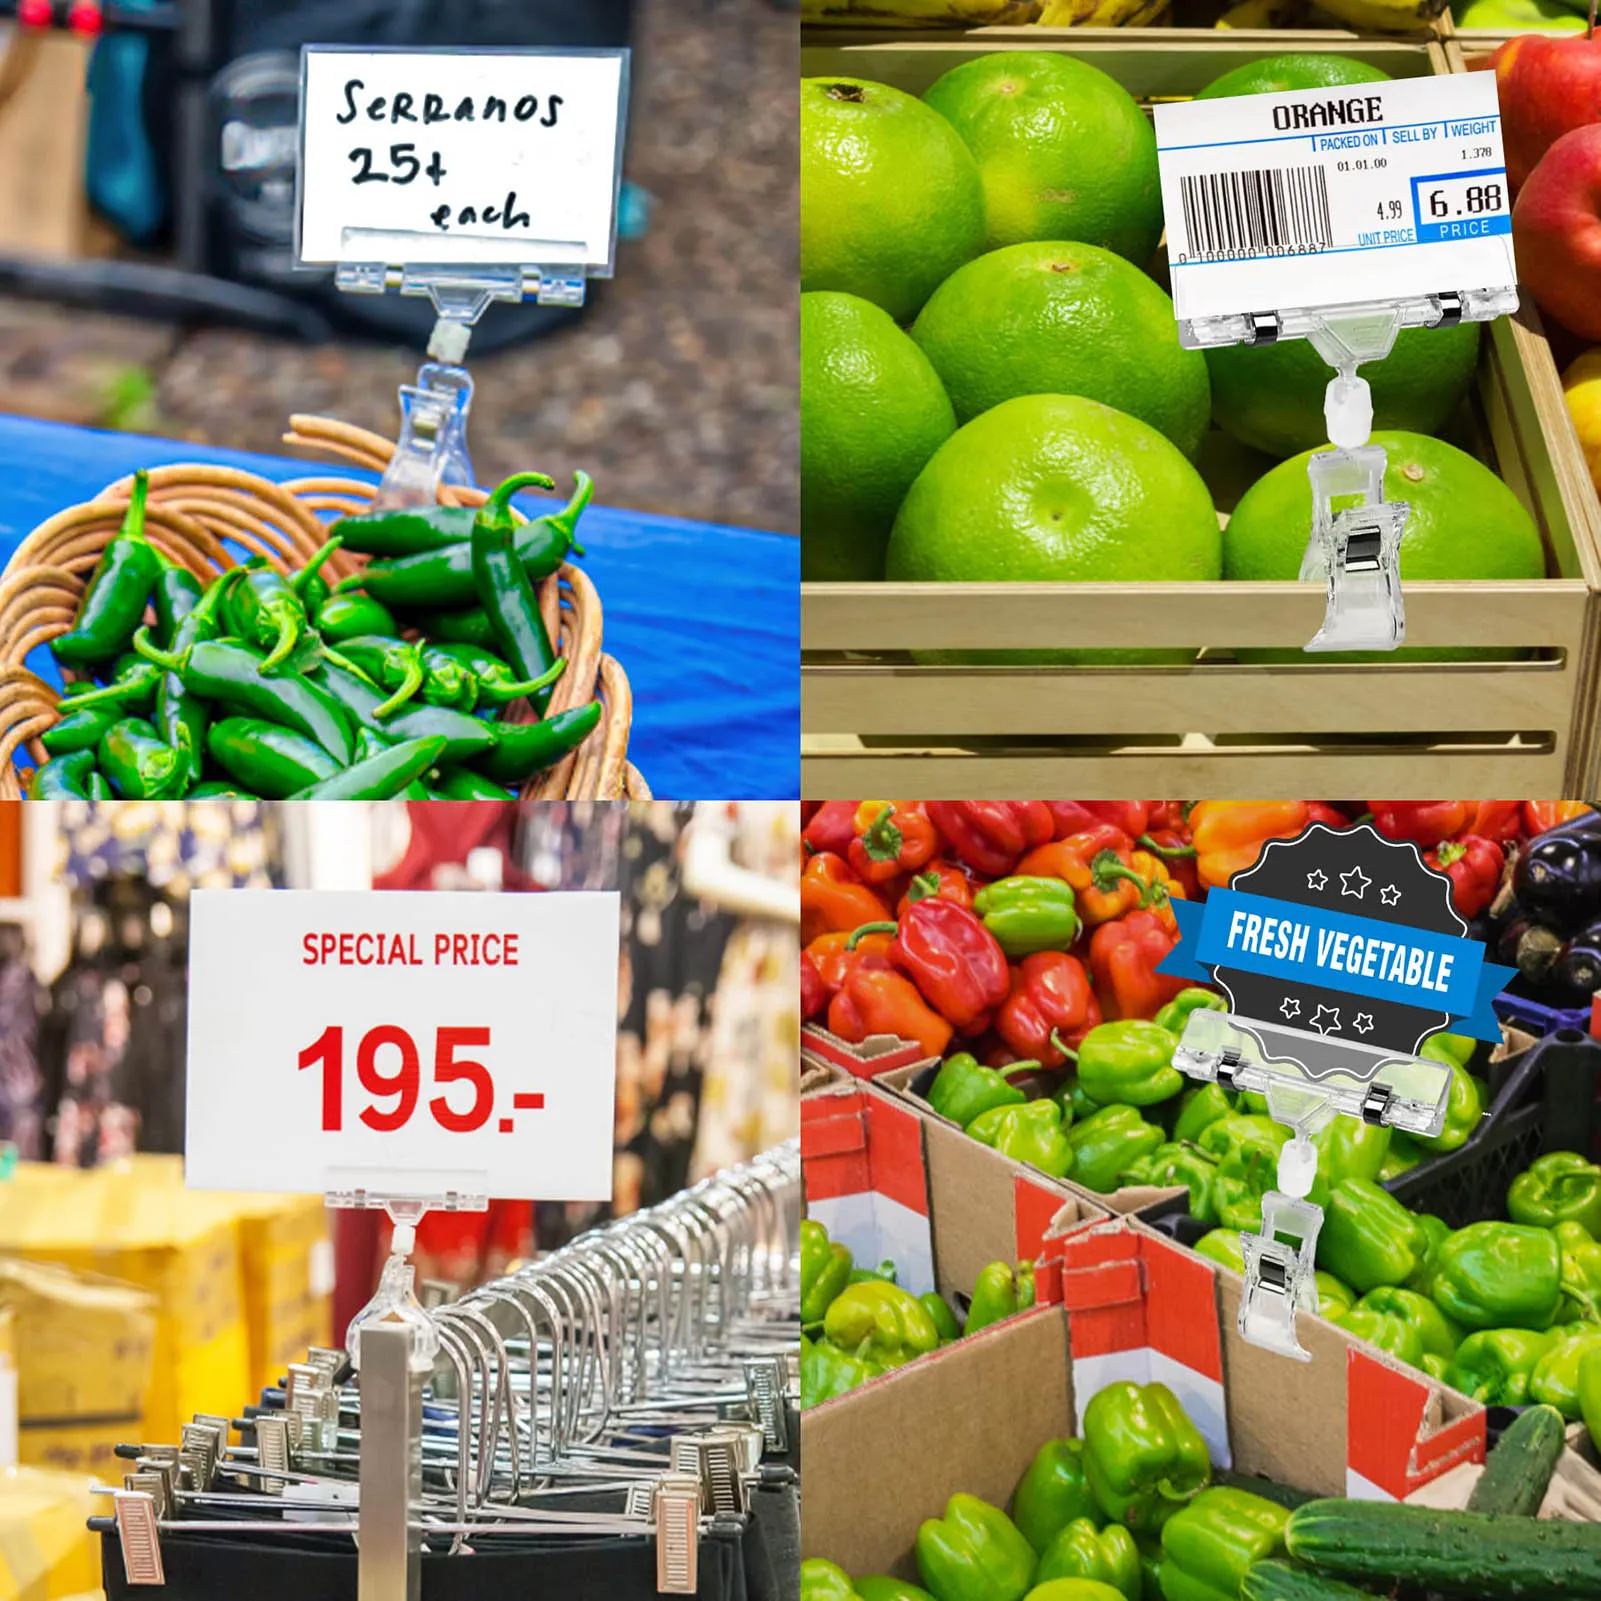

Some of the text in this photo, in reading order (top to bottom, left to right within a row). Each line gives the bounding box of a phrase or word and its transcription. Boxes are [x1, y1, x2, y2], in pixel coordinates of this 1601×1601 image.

[1272, 96, 1383, 131] ORANGE
[1392, 127, 1438, 144] SELL BY
[1450, 120, 1496, 137] WEIGHT
[1320, 134, 1378, 151] PACKED ON
[1461, 147, 1492, 160] 1.378
[1337, 158, 1388, 172] 01.01.00
[1430, 184, 1501, 217] 6.88
[430, 191, 530, 230] each
[1377, 200, 1402, 221] 4.99
[1357, 228, 1415, 247] UNIT PRICE
[1440, 219, 1490, 238] PRICE
[1178, 252, 1188, 265] 0
[303, 933, 519, 966] SPECIAL PRICE
[1227, 910, 1454, 993] FRESH VEGETABLE
[298, 1024, 545, 1133] 195.-
